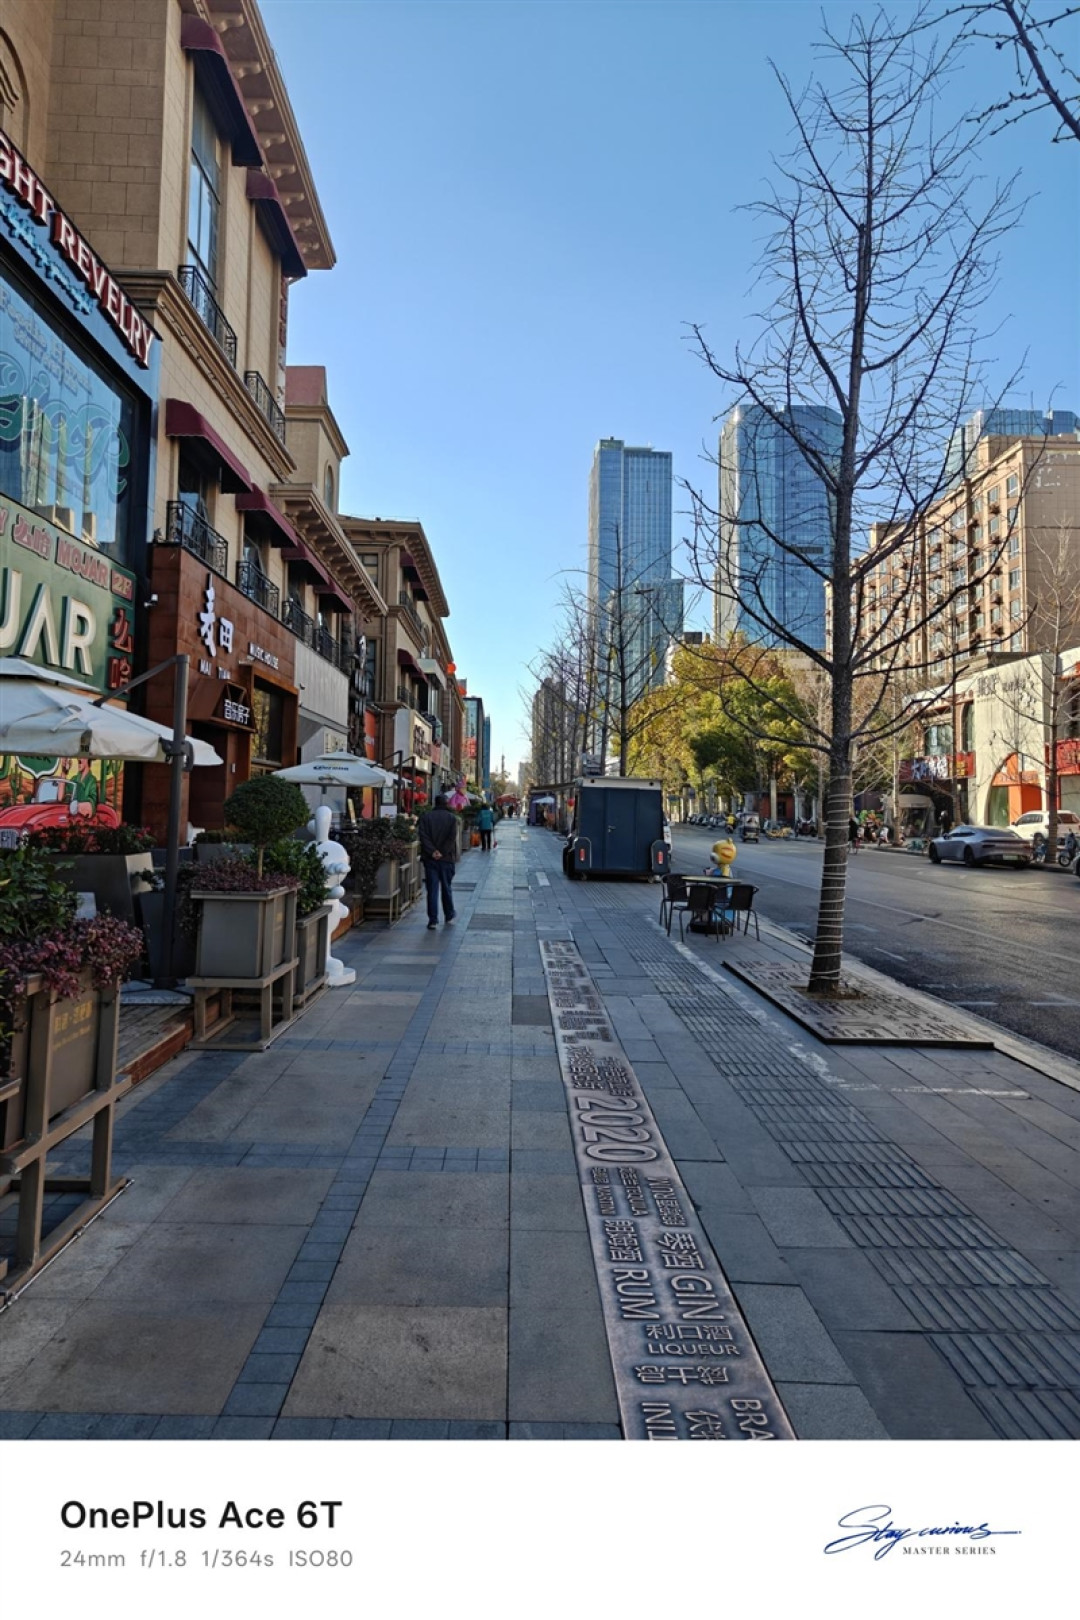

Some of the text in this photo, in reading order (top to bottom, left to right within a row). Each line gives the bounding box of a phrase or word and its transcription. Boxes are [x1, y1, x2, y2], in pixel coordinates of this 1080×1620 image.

[53, 211, 154, 369] REVELRY
[56, 536, 109, 591] MOJAR
[574, 1096, 660, 1162] 2020
[603, 1218, 661, 1320] 朗姆酒 RUM
[656, 1231, 725, 1320] 琴酒 GIN
[645, 1323, 734, 1341] 利口酒
[647, 1342, 741, 1356] LIQUEUR
[633, 1364, 730, 1385] 威士忌
